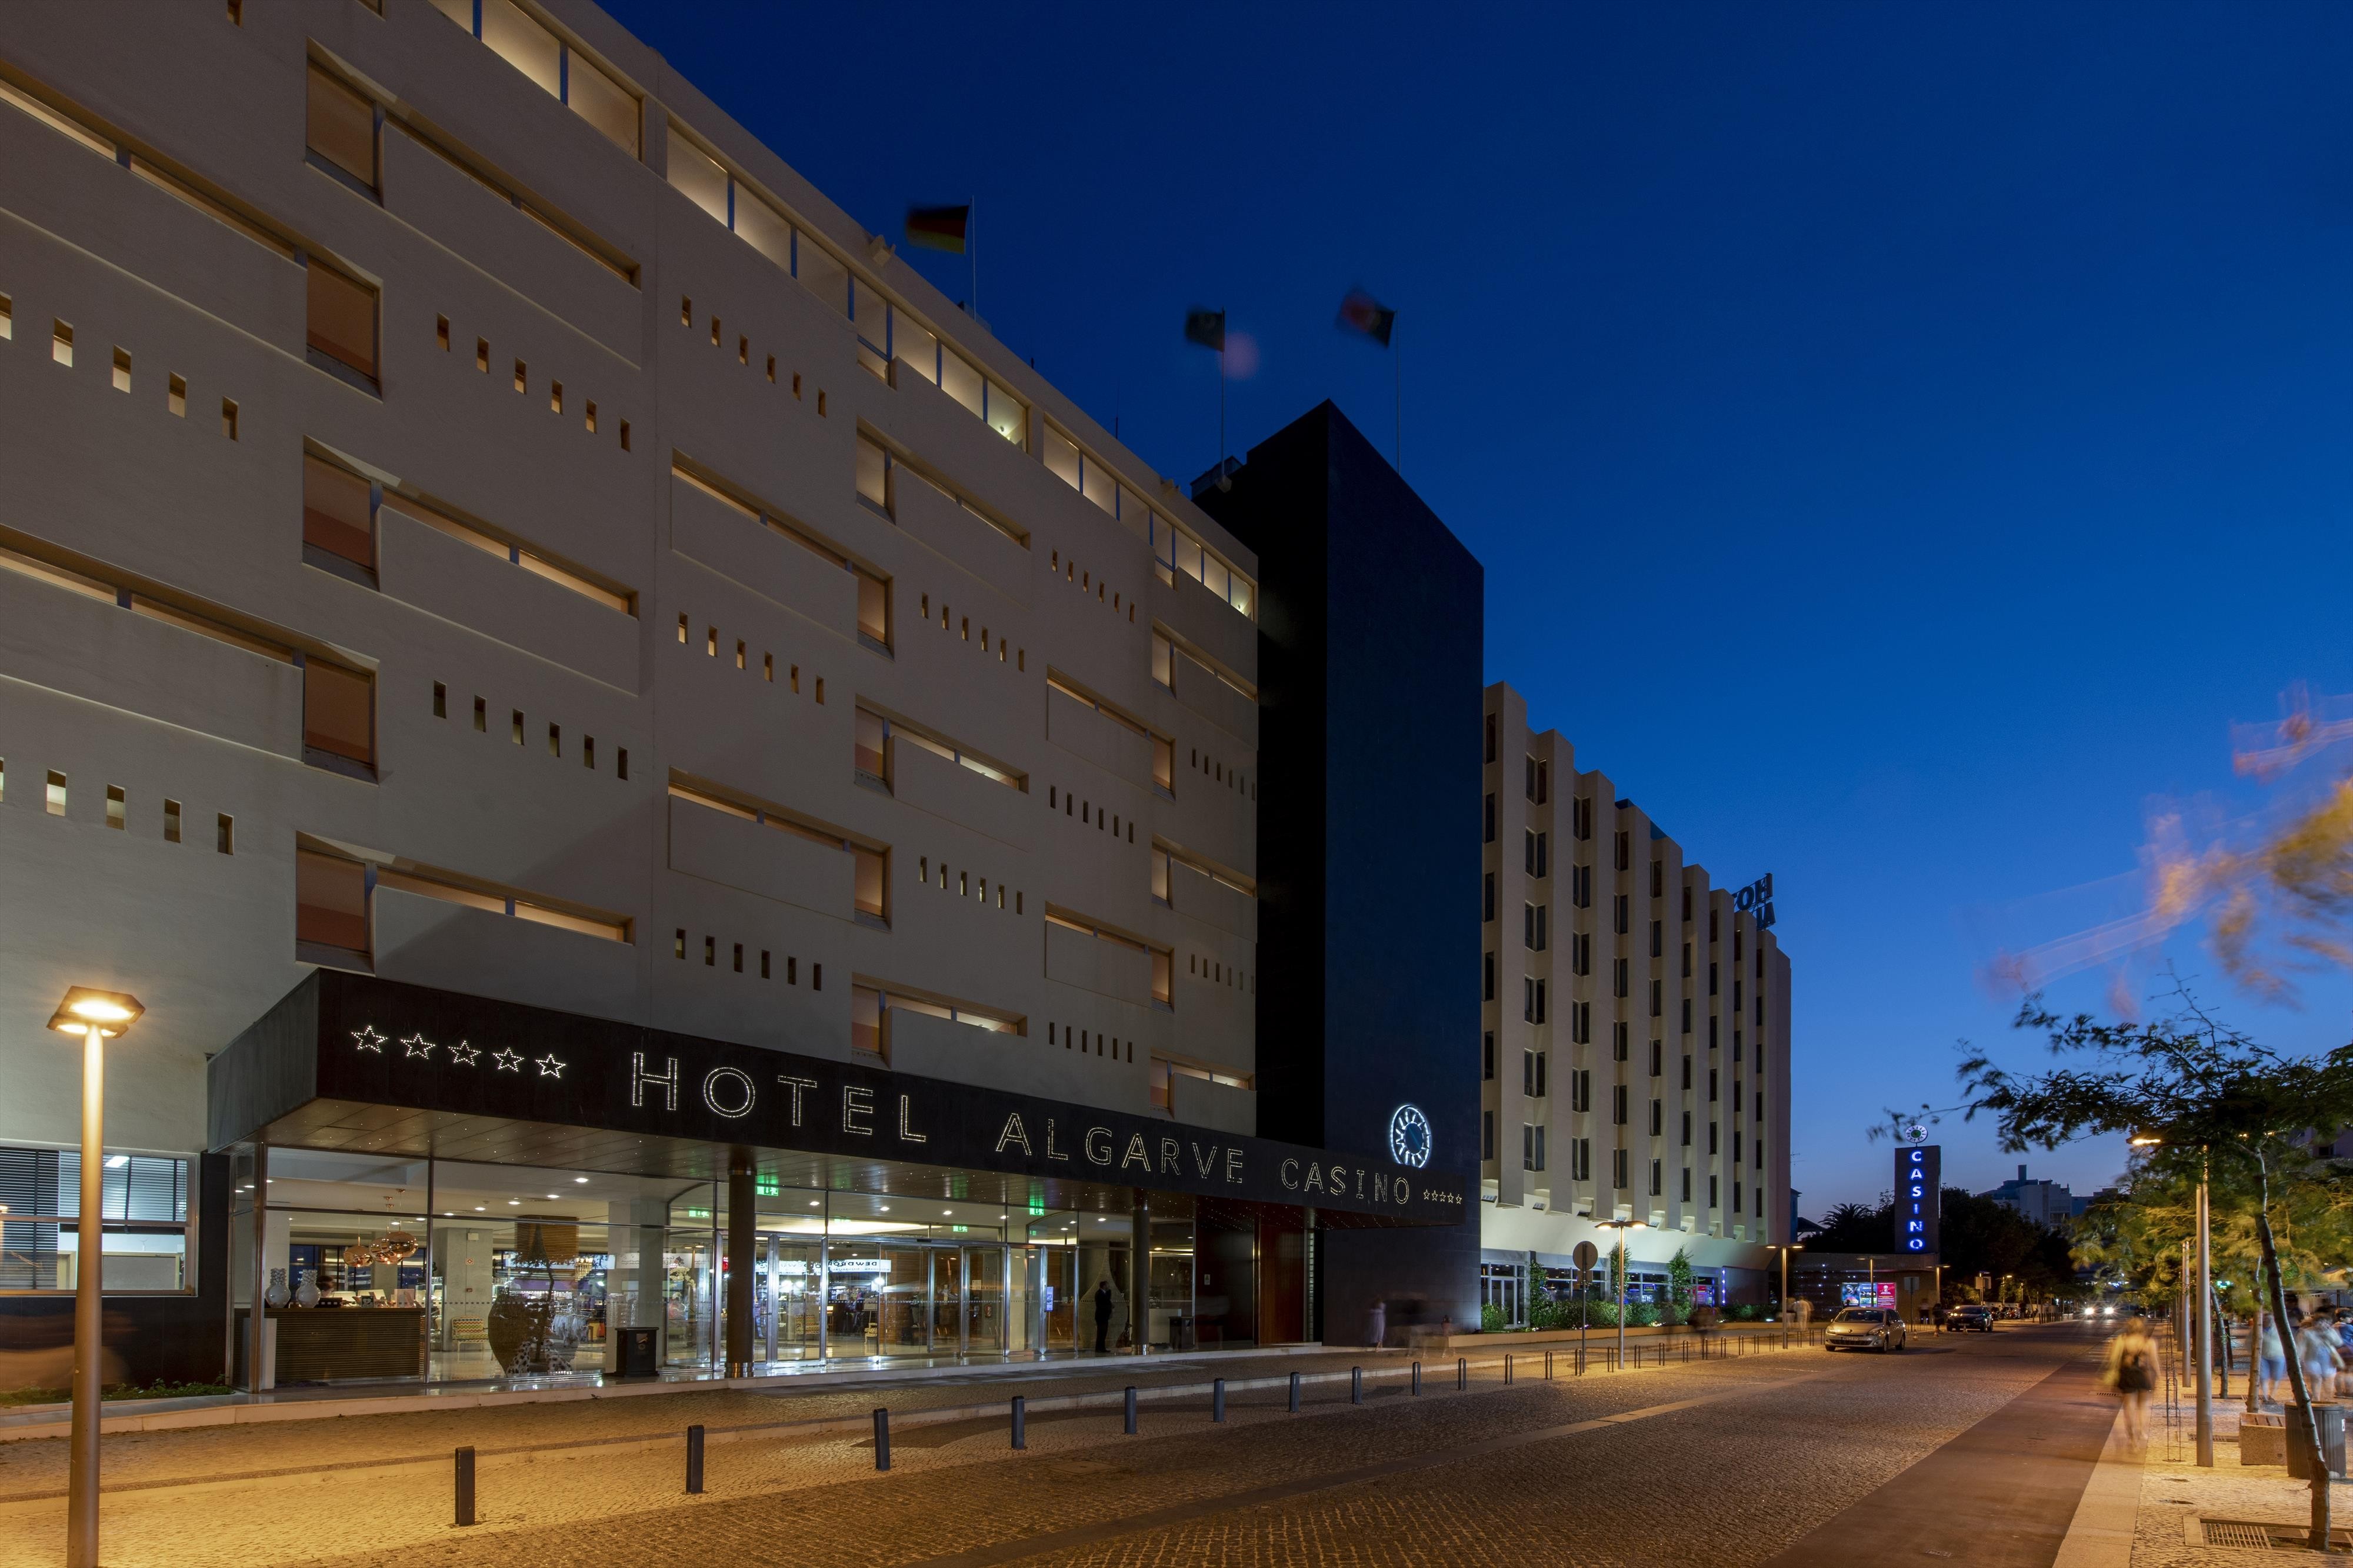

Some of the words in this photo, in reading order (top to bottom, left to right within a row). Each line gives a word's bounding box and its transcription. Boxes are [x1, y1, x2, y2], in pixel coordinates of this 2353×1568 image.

[632, 1052, 927, 1142] HOTEL
[995, 1113, 1244, 1184] ALGARVE
[1281, 1158, 1410, 1206] CASINO
[1909, 1151, 1923, 1249] CASINO
